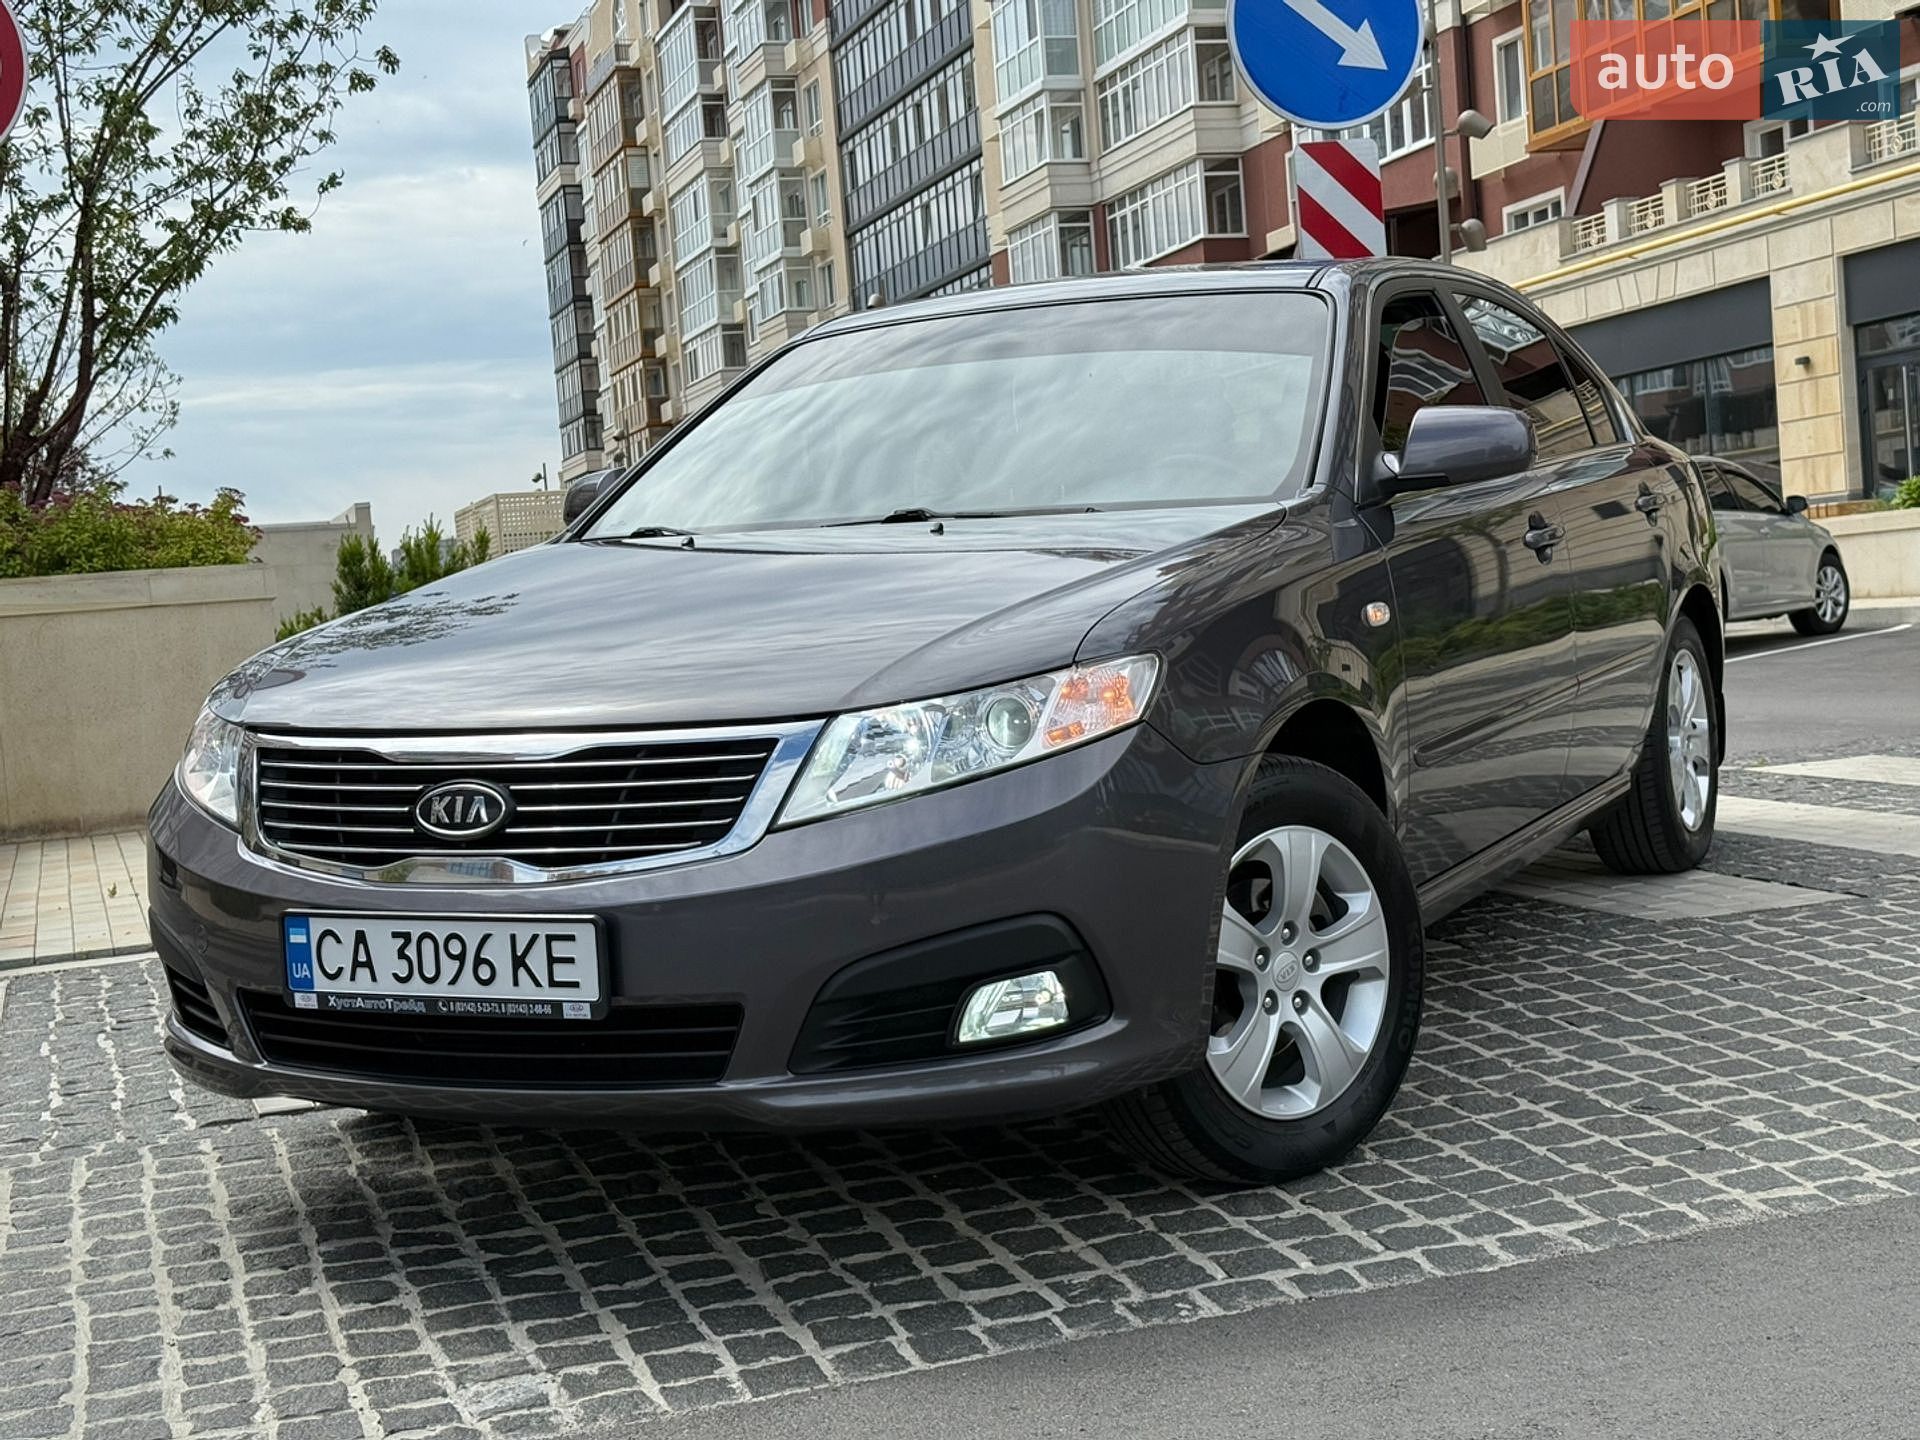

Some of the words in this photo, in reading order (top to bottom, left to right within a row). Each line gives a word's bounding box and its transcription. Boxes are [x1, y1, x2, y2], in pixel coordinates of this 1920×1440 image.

[430, 795, 489, 824] KIA
[292, 962, 311, 979] UA
[316, 928, 378, 983] CA
[391, 931, 497, 987] 3096
[509, 932, 581, 988] KE
